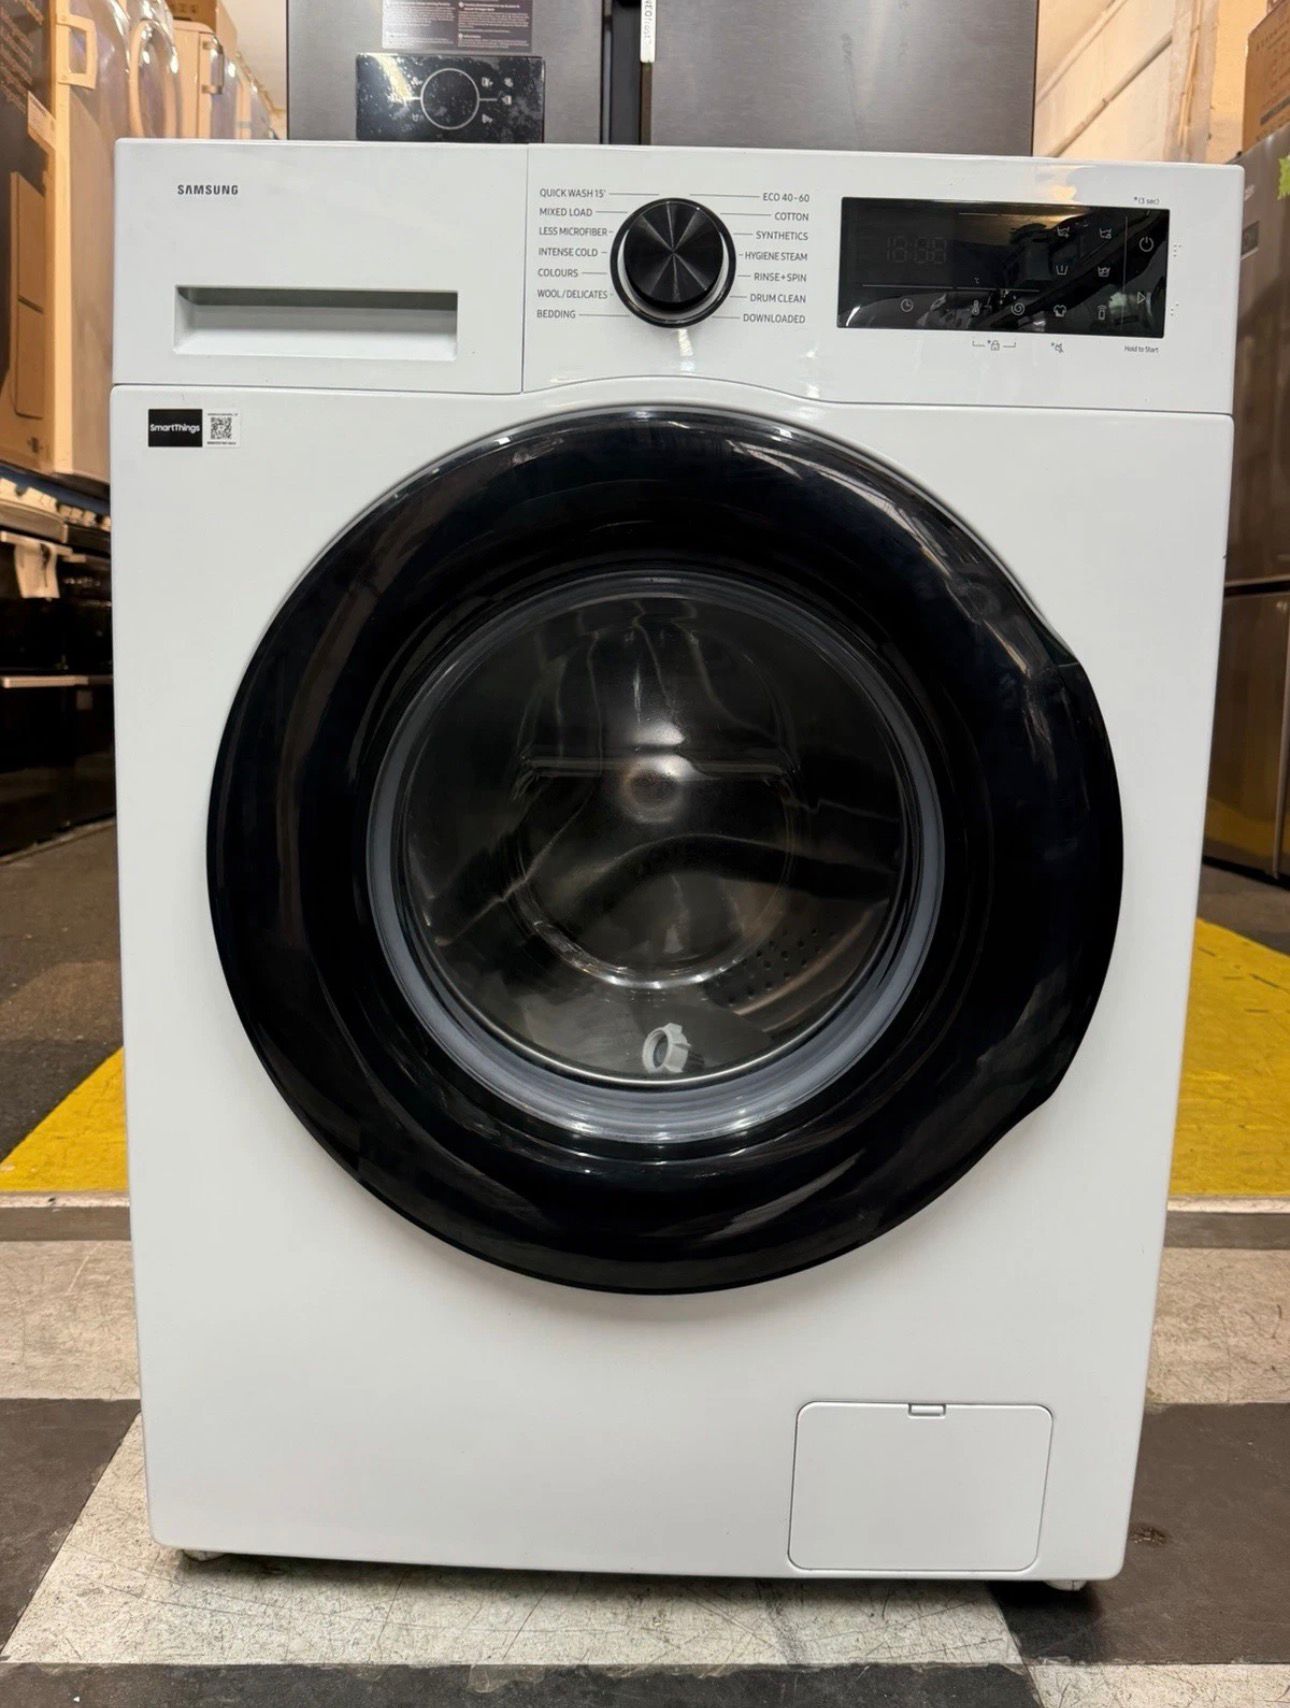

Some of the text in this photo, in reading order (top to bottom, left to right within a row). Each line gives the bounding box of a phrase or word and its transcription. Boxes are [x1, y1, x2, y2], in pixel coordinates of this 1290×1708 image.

[177, 184, 239, 196] SAMSUNG
[539, 188, 567, 198] QUICK
[567, 188, 593, 198] WASH
[762, 192, 810, 203] ECO 40-60
[539, 207, 593, 217] MIXED LOAD
[774, 211, 810, 221] COTTON
[539, 226, 608, 237] LESS MICROFIBER
[755, 230, 809, 241] SYNTHETICS
[538, 247, 598, 257] INTENSE COLD
[745, 251, 808, 261] HYGIENE STEAM
[537, 268, 579, 278] COLOURS
[750, 293, 807, 303] DRUM CLEAN
[536, 309, 576, 319] BEDDING
[743, 313, 806, 324] DOWNLOADED
[149, 423, 200, 435] SmartThings
